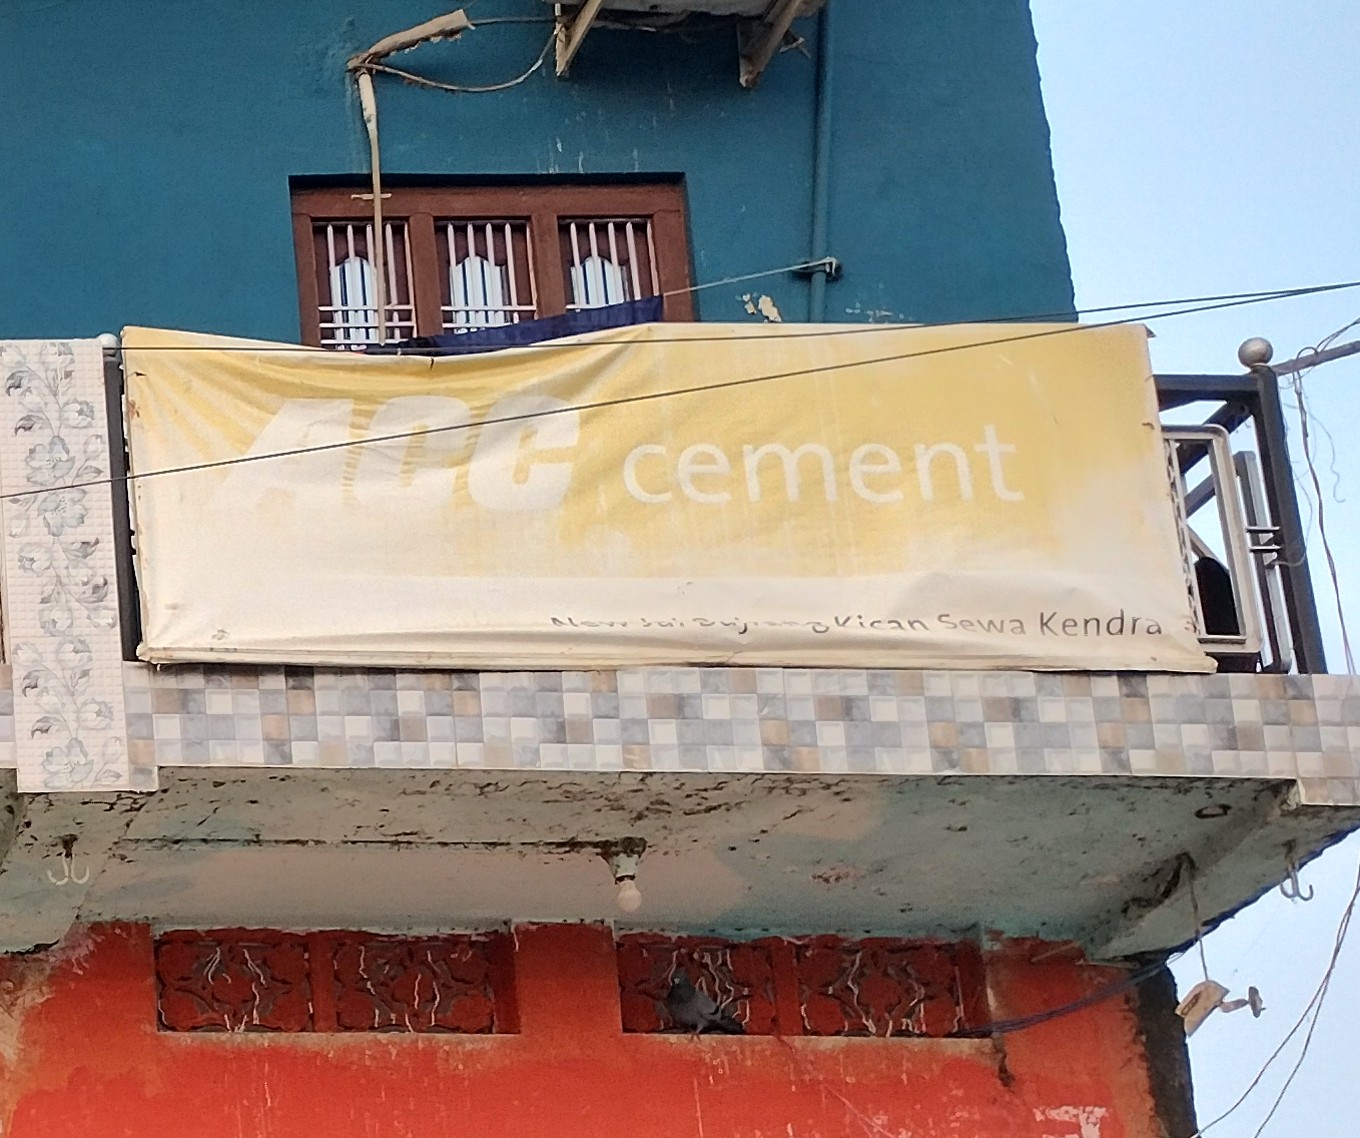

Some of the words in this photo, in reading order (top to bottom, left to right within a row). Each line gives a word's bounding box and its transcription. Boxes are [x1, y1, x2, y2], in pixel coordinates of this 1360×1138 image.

[212, 394, 581, 511] ACC
[624, 423, 1025, 504] cement
[1039, 608, 1163, 637] Kendra
